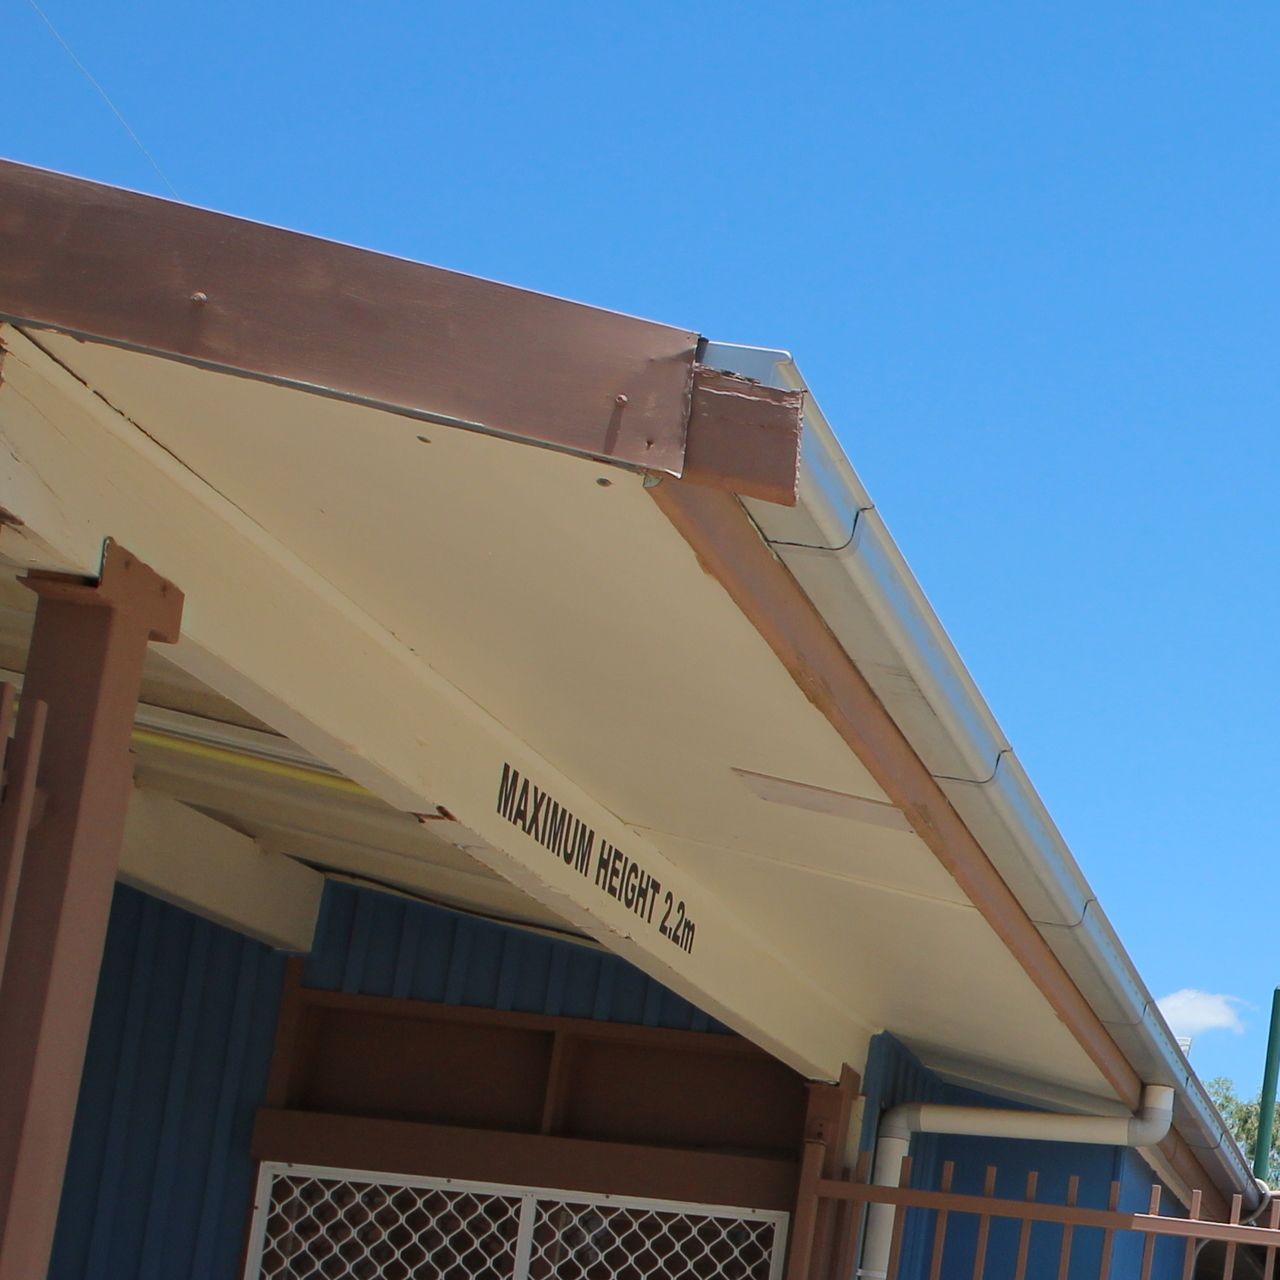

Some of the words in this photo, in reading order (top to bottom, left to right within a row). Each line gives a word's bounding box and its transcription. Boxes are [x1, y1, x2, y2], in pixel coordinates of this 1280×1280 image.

[497, 762, 594, 877] MAXIMUM
[595, 840, 660, 923] HEIGHT
[659, 891, 695, 954] 2.2m
